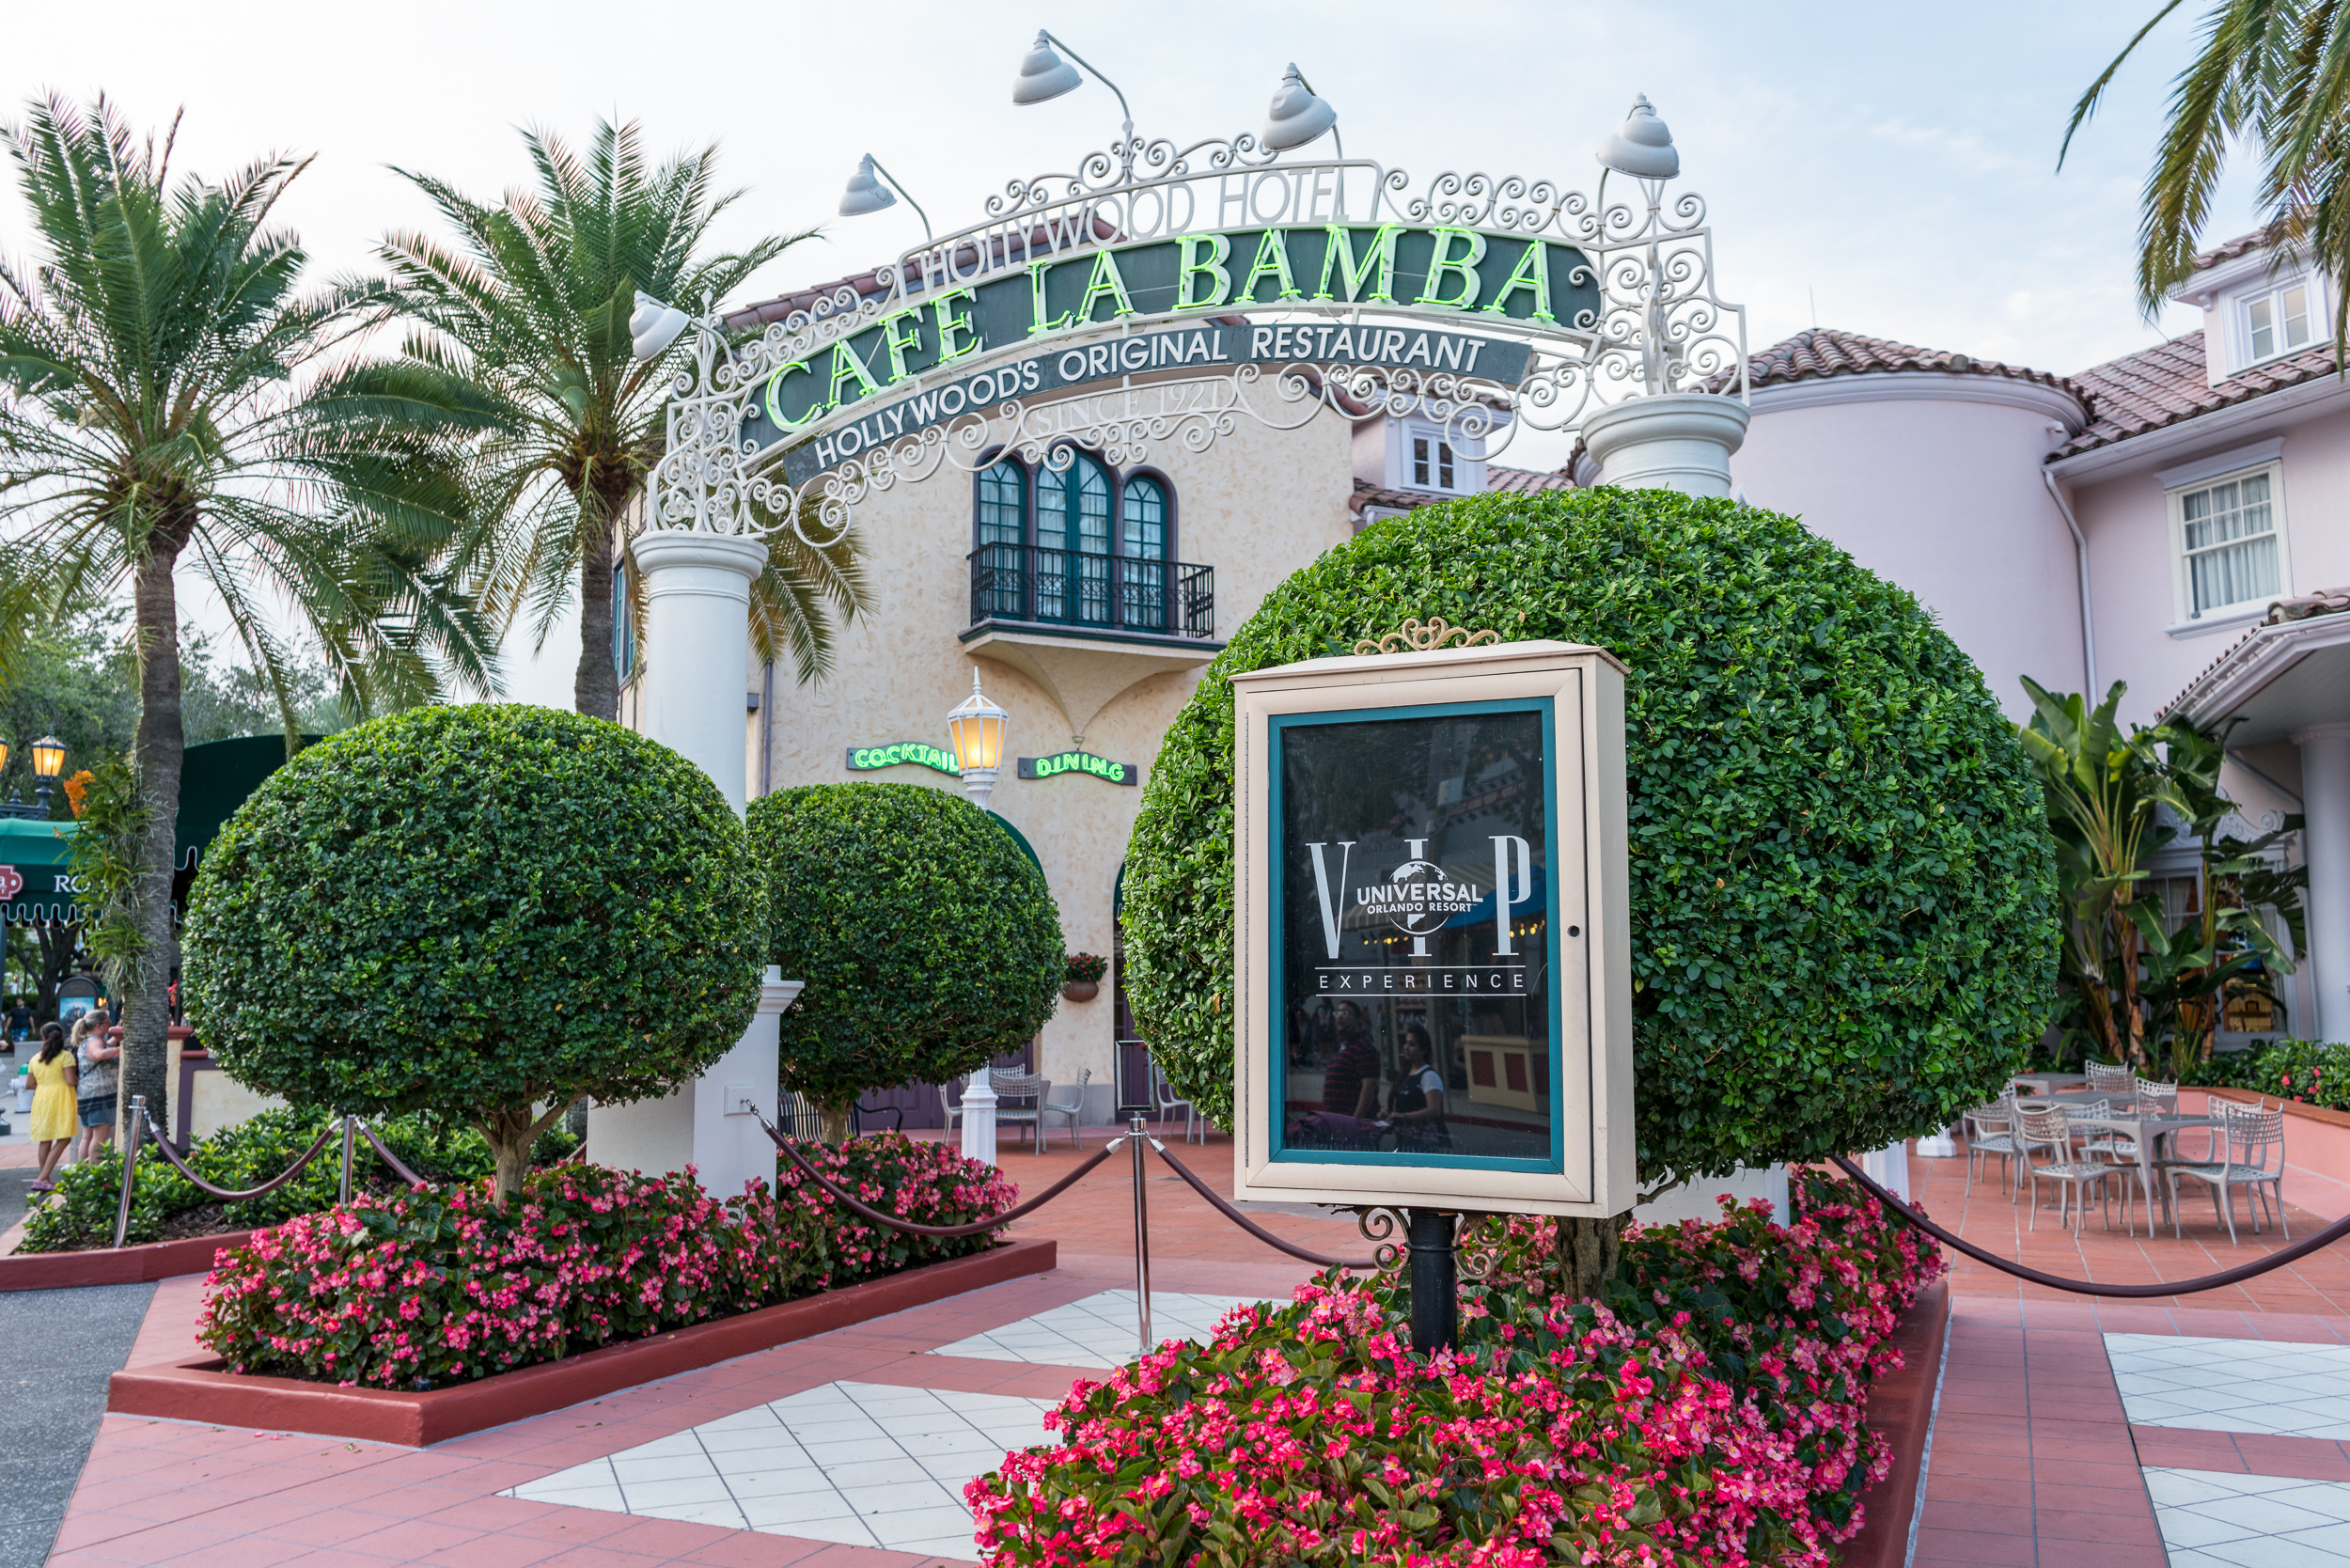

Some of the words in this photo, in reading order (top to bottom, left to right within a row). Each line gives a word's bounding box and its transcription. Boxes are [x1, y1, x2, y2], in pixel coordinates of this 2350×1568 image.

[920, 181, 1194, 297] HOLLYWOOD
[1218, 166, 1349, 229] HOTEL
[766, 287, 983, 432] CAFE
[1024, 248, 1144, 334] LA
[1172, 223, 1560, 329] BAMBA
[815, 360, 1039, 469] HOLLYWOOD'S
[1059, 330, 1228, 381] ORIGINAL
[1251, 326, 1486, 372] RESTAURANT
[1036, 390, 1141, 434] SINCE
[1157, 380, 1224, 415] 1921
[1036, 753, 1125, 782] DINING
[1306, 835, 1531, 959] VIP
[1356, 883, 1483, 905] UNIVERSAL
[1367, 902, 1423, 915] ORLANDO
[1429, 902, 1473, 913] RESORT
[1319, 974, 1524, 988] EXPERIENCE
